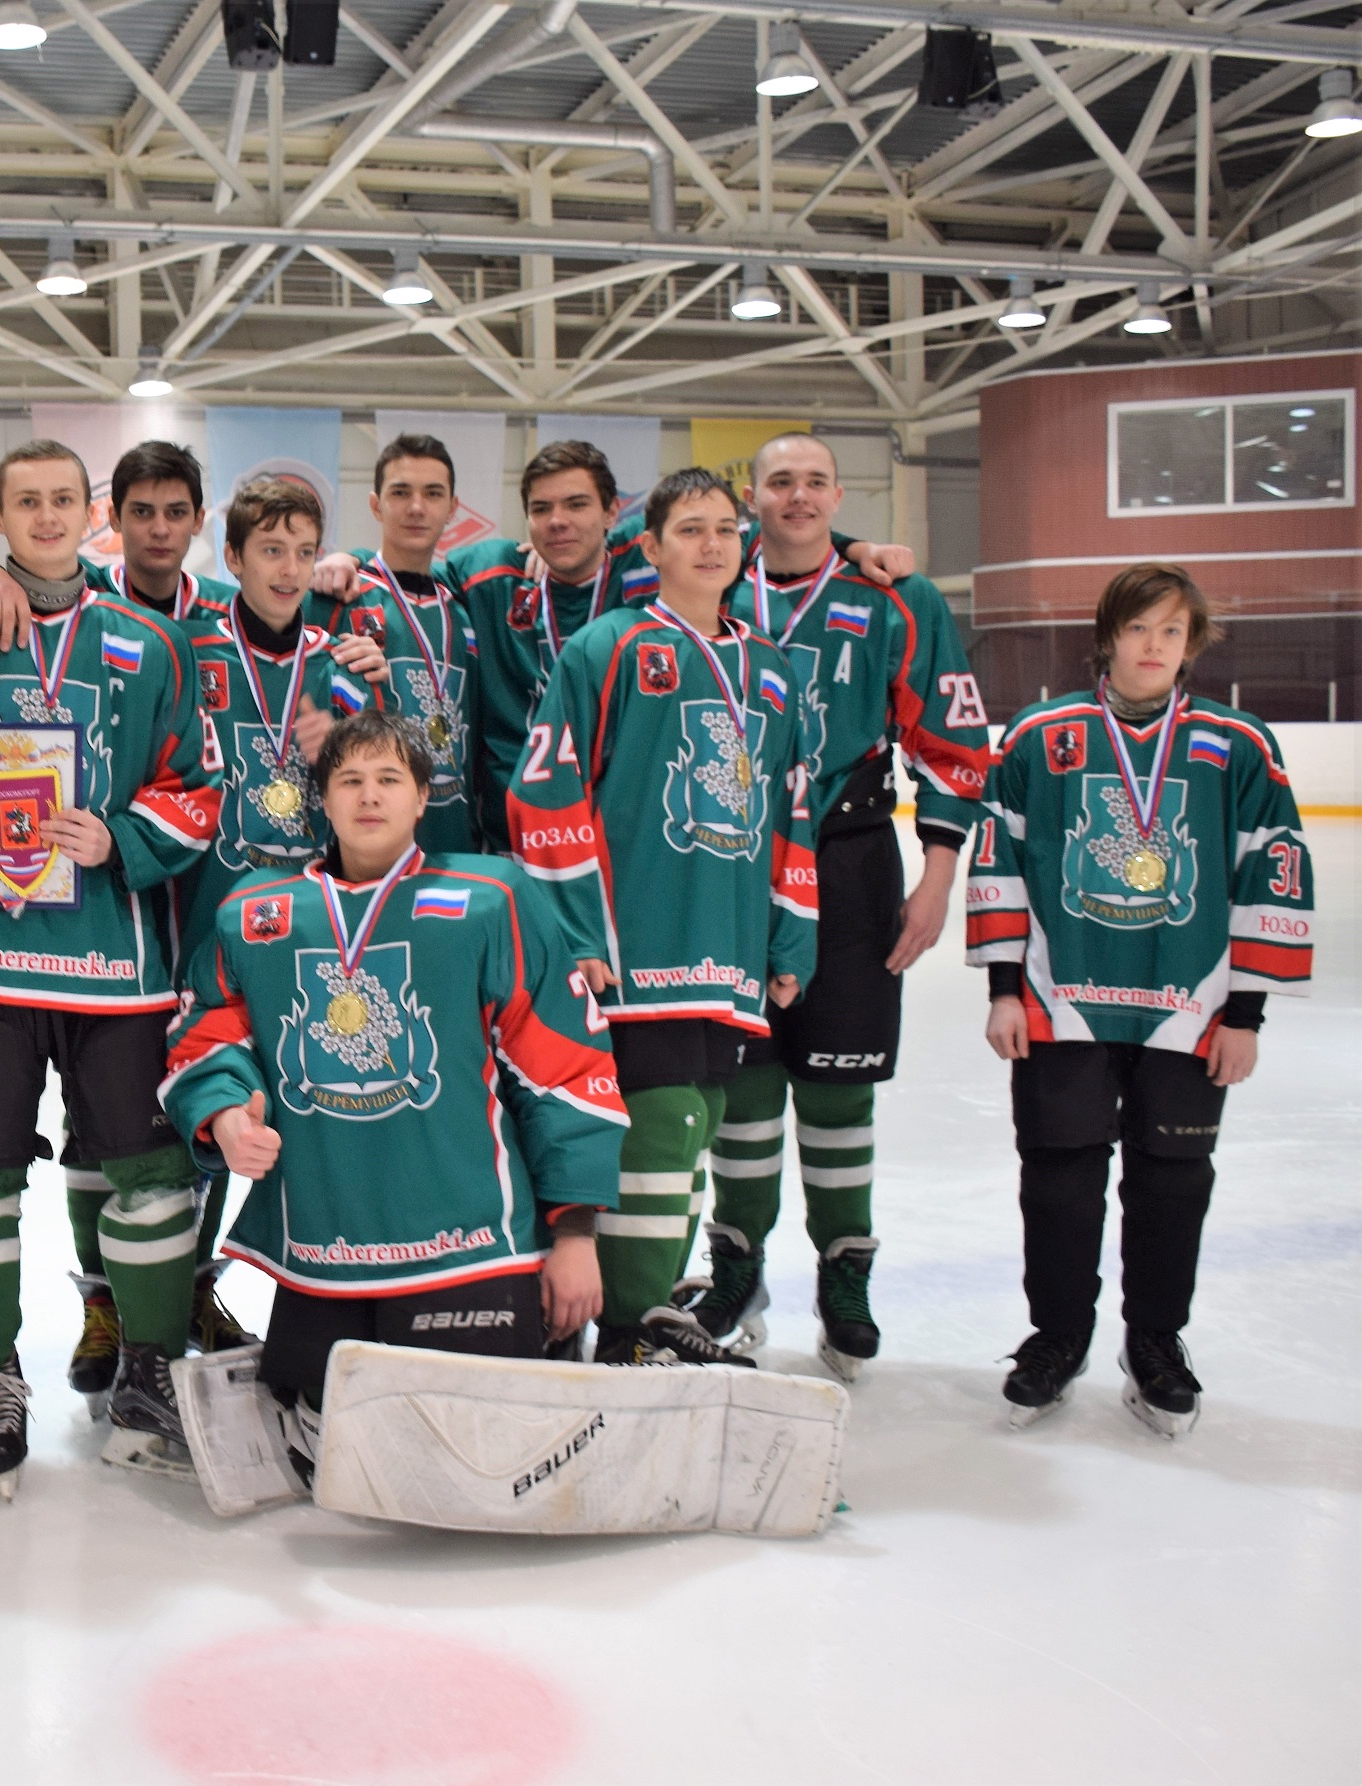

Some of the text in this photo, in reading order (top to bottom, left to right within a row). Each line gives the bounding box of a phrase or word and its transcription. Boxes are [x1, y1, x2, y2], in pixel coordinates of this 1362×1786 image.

[833, 640, 852, 685] A
[938, 671, 989, 729] 29
[522, 721, 582, 784] 24
[521, 824, 596, 850] ЮЗАО
[783, 867, 818, 886] ЮЗ
[1268, 841, 1302, 900] 31
[806, 1052, 886, 1068] CCM
[411, 1310, 516, 1331] BAUER
[512, 1411, 605, 1498] BAUER
